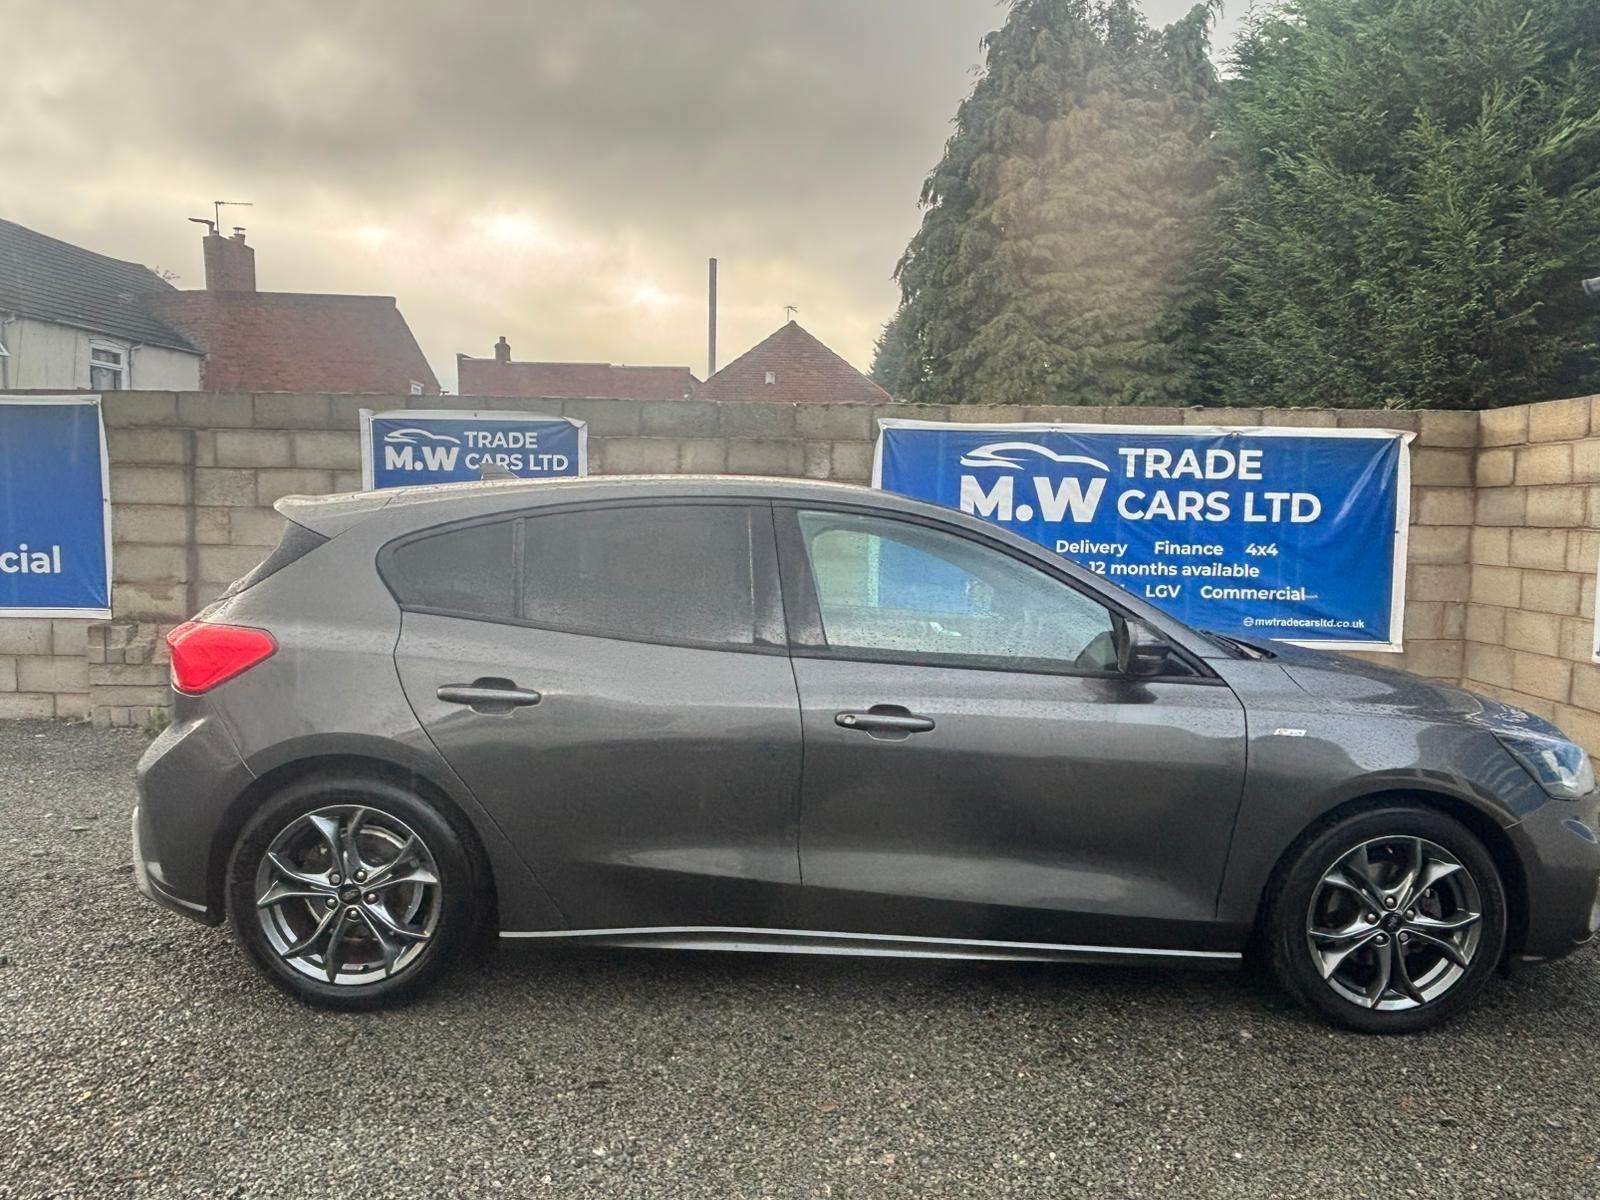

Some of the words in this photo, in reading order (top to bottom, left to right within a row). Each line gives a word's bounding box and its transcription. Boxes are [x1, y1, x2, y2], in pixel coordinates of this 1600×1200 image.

[464, 431, 538, 448] TRADE
[384, 446, 460, 471] M.W
[529, 454, 569, 471] LTD
[1118, 448, 1263, 480] TRADE
[960, 475, 1107, 523] M.W
[1117, 489, 1230, 521] CARS
[1243, 492, 1322, 523] LTD
[1056, 540, 1128, 557] Delivery
[1154, 541, 1224, 556] Finance
[1245, 543, 1279, 556] 4x4
[1110, 562, 1177, 576] months
[1181, 563, 1261, 577] available
[1145, 585, 1181, 598] LGV
[1200, 586, 1306, 601] Commercial
